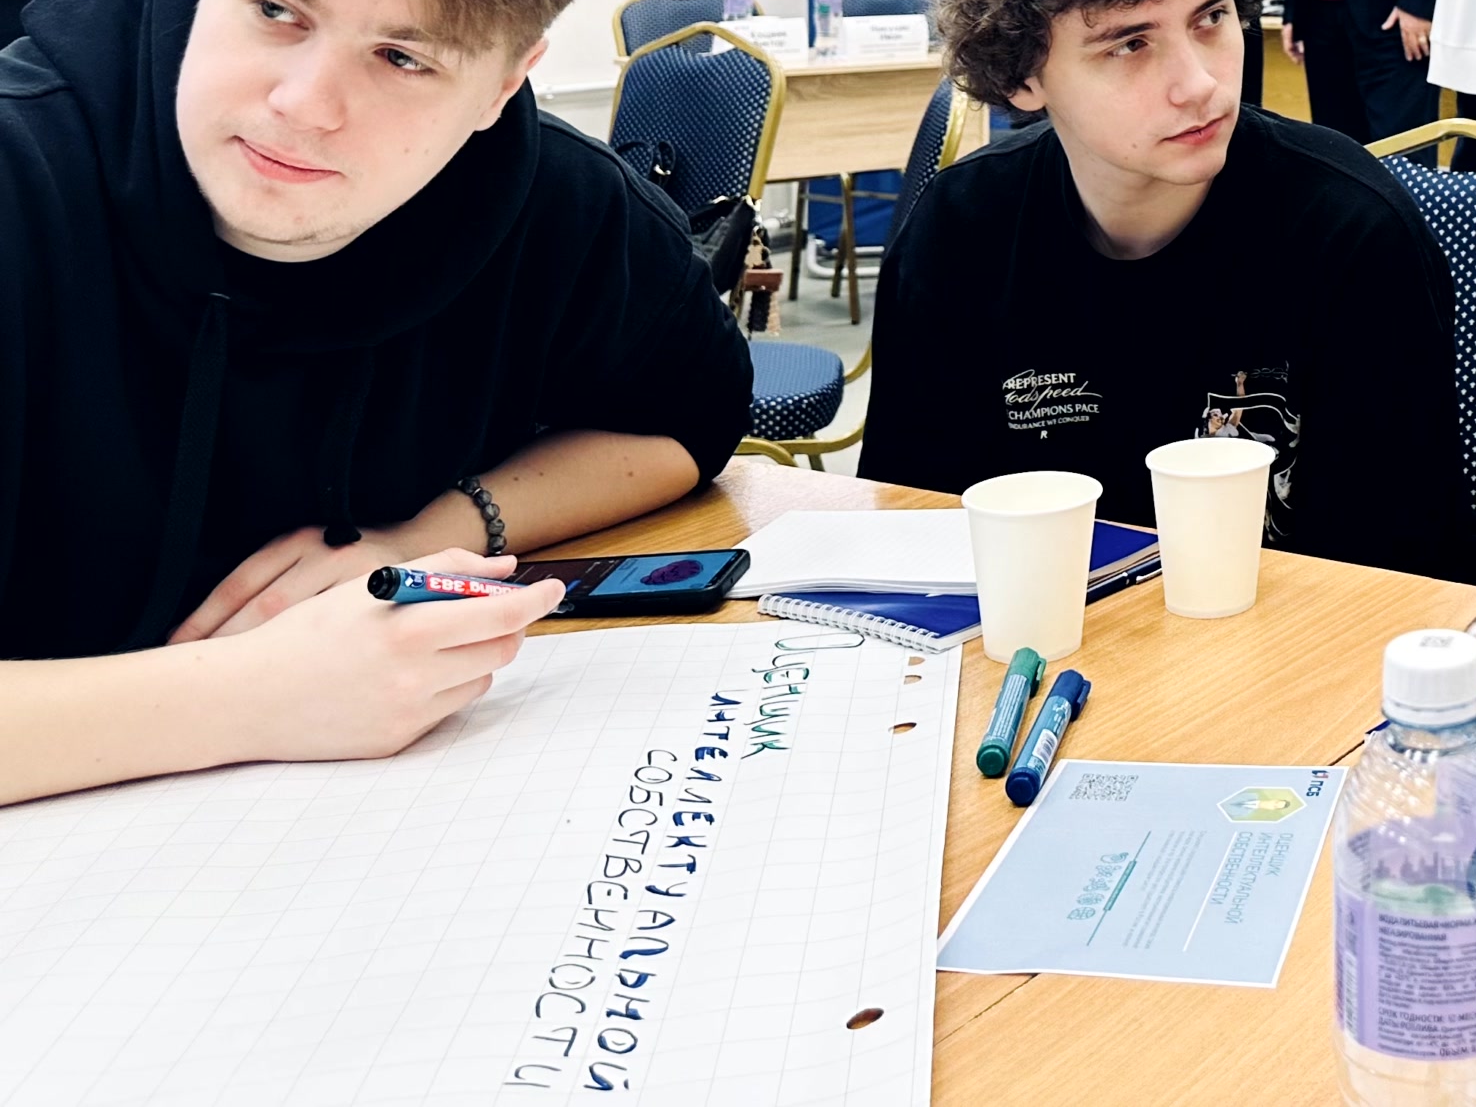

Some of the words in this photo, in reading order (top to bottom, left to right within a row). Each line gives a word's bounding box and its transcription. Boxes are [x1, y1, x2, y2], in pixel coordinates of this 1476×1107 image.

[1006, 373, 1076, 390] REPRESENT
[1008, 404, 1074, 421] CHAMPIONS
[1075, 403, 1100, 414] PACE
[1040, 430, 1048, 440] R
[429, 575, 465, 593] 383
[1306, 780, 1324, 797] ПСБ
[1209, 831, 1253, 905] СОБСТВЕННОСТИ
[1265, 833, 1294, 876] ОЦЕНЩИК
[583, 689, 744, 1092] ИНТЕЛЛЕКТУАЛЬНОЙ
[1224, 832, 1272, 924] ИНТЕЛЛЕКТУАЛЬНОЙ
[503, 749, 678, 1088] СОБСТВЕННОСТИ
